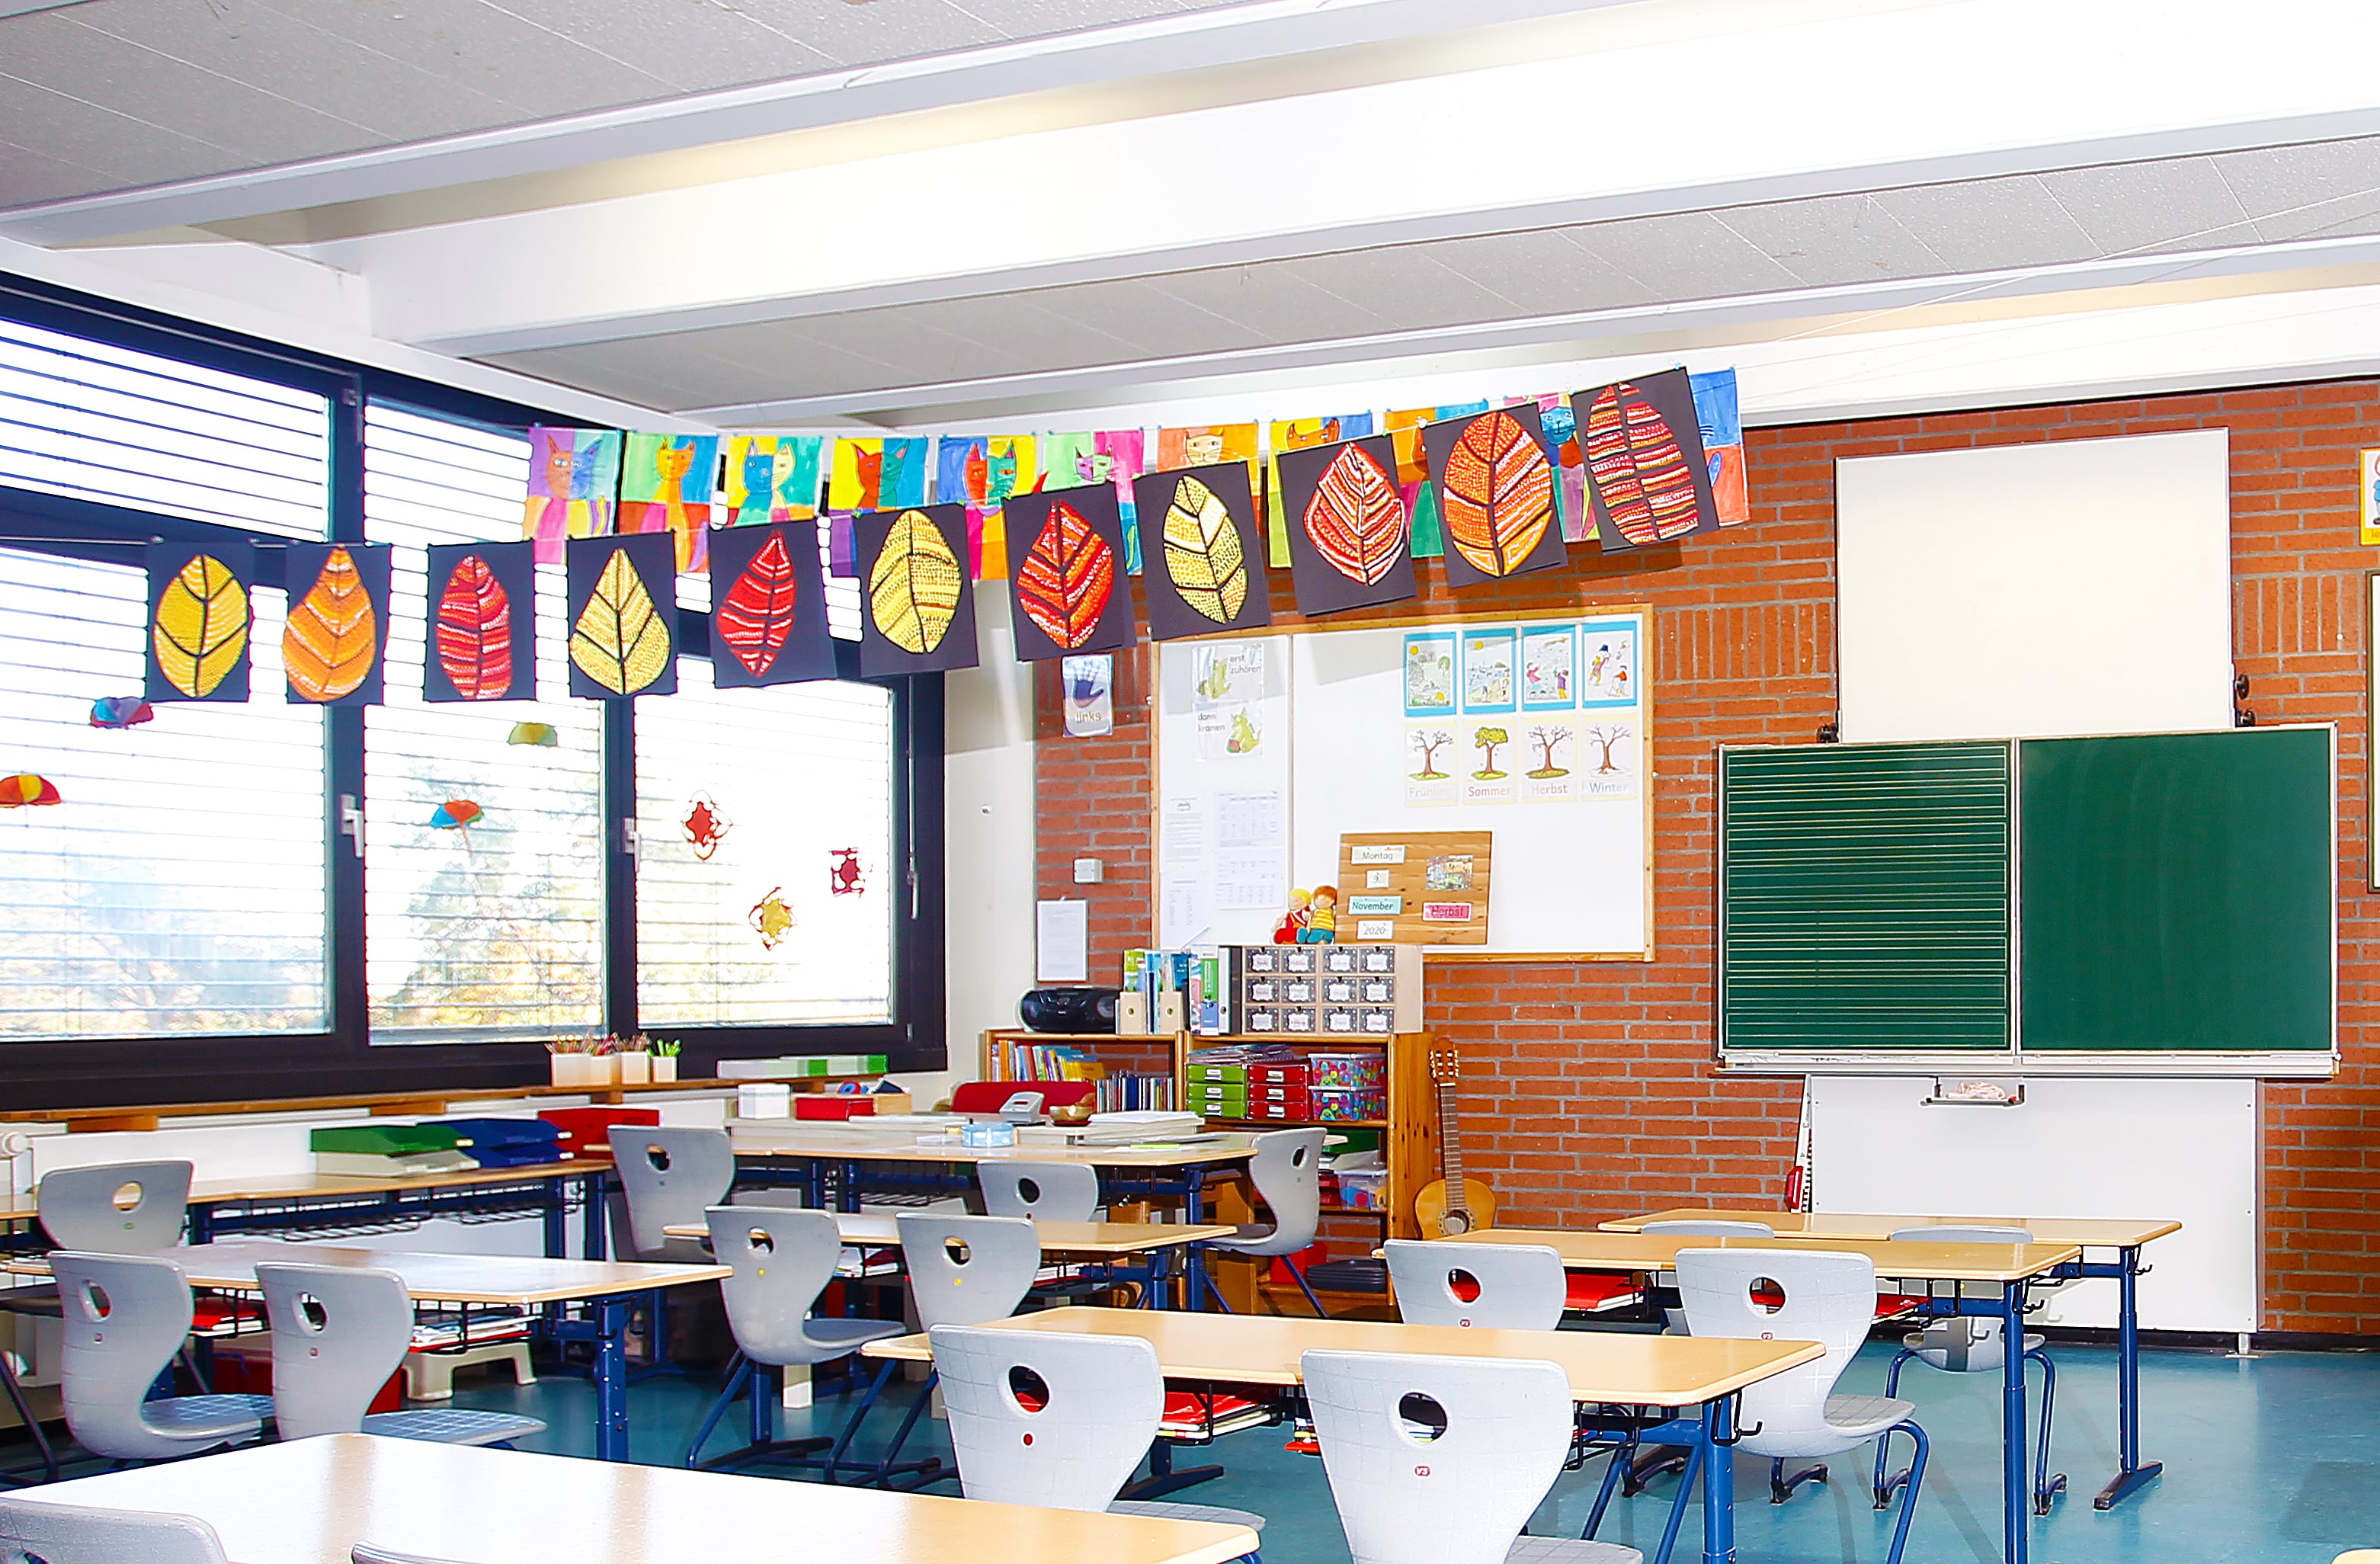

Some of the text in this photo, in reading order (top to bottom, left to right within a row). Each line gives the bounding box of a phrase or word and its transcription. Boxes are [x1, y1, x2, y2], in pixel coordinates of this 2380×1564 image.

[1076, 711, 1101, 723] links
[1468, 786, 1510, 797] Sommer
[1531, 784, 1568, 795] Herbst
[1590, 782, 1628, 793] Winter
[1362, 851, 1393, 861] Montag
[1373, 875, 1381, 883] 9.
[1352, 901, 1394, 911] November
[1430, 907, 1463, 918] Herbst
[1363, 926, 1386, 935] 2020
